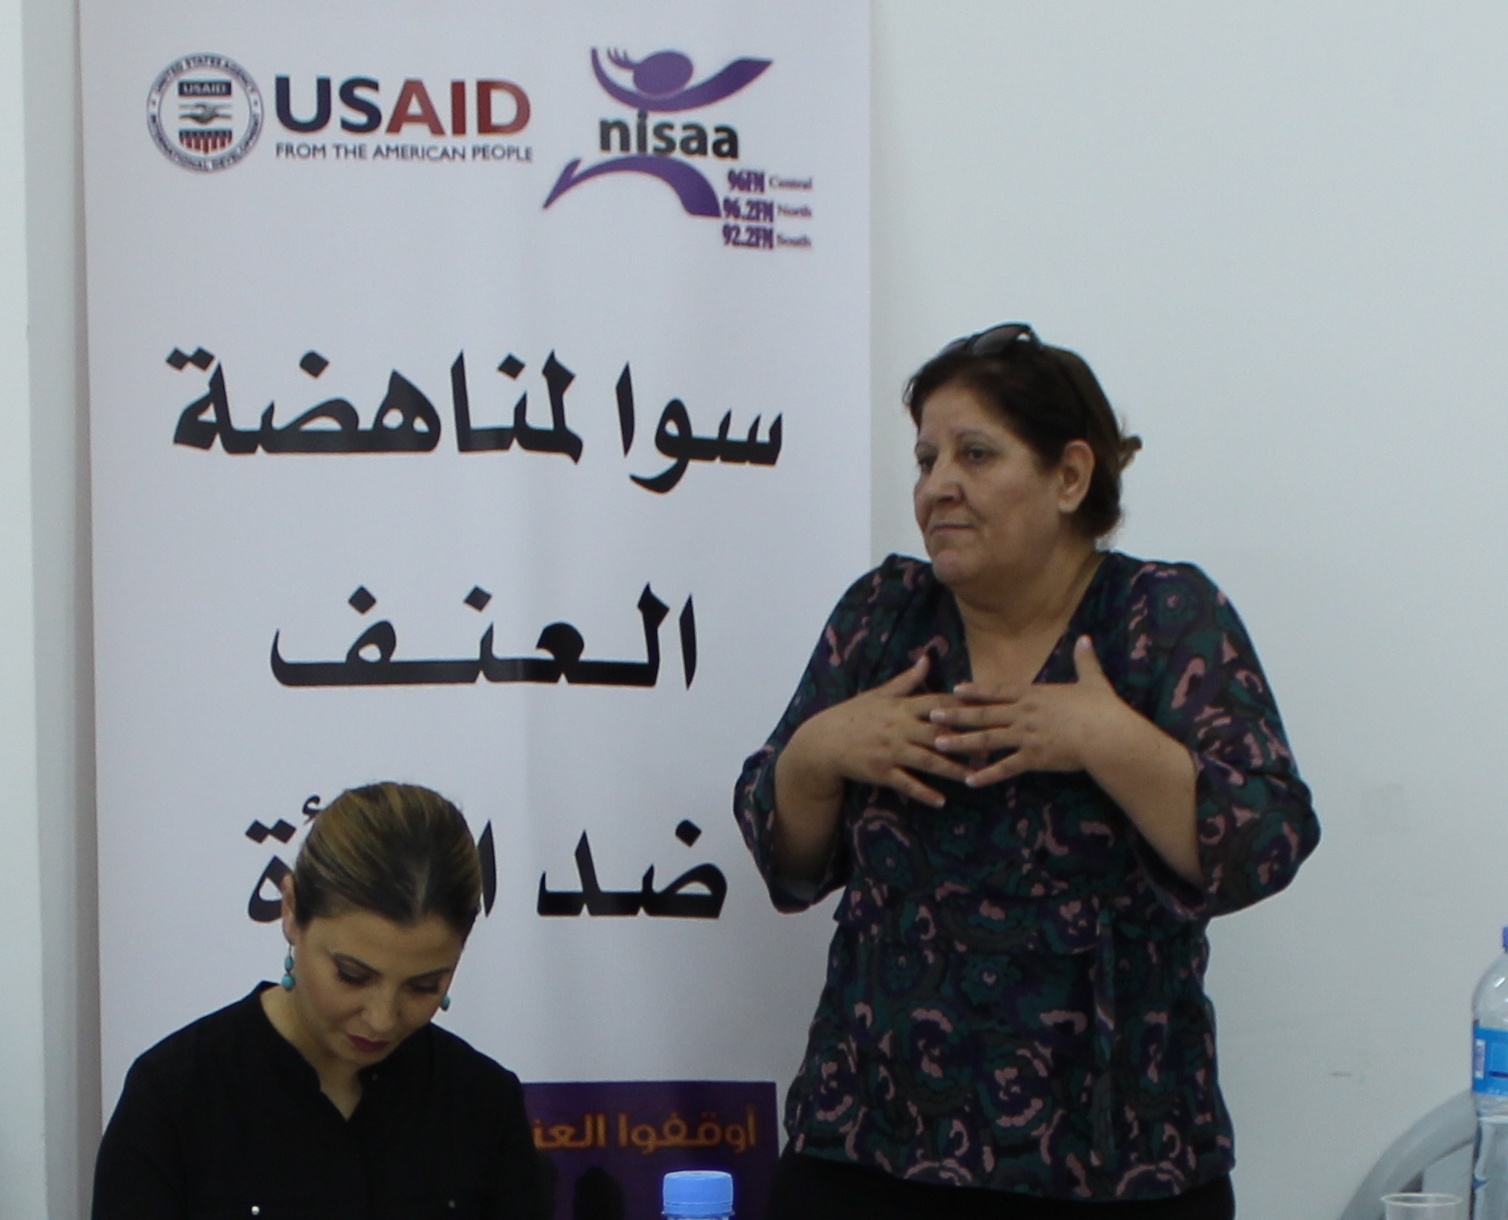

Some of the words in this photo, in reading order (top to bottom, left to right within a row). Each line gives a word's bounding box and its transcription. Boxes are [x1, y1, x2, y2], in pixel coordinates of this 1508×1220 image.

[183, 82, 227, 94] USAID
[275, 75, 531, 136] USAID
[276, 142, 326, 160] FROM
[333, 143, 366, 160] THE
[373, 143, 465, 161] AMERICAN
[471, 144, 533, 163] PEOPLE
[599, 109, 739, 159] nisaa
[166, 346, 584, 465] لمناهضة
[614, 360, 783, 494] سوا
[270, 581, 698, 691] العنف
[536, 819, 728, 919] ضد
[533, 1113, 606, 1150] العن
